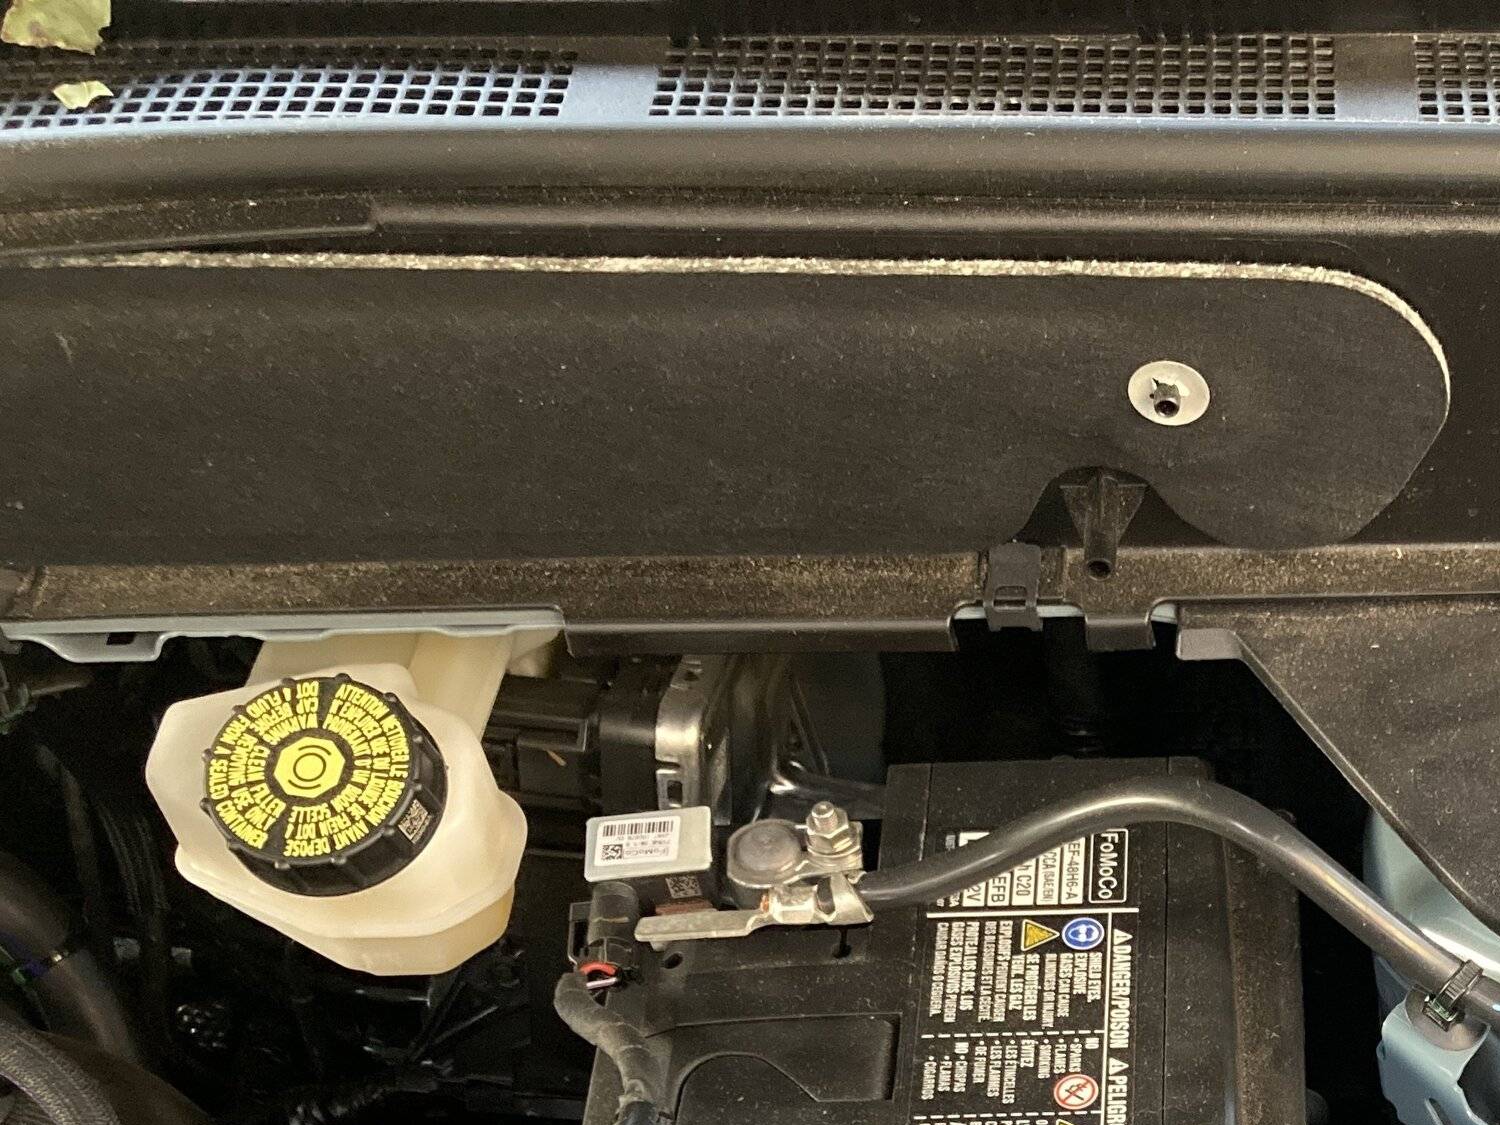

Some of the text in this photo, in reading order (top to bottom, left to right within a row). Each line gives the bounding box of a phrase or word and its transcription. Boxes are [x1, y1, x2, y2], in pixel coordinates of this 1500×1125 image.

[246, 691, 282, 717] FLUID
[297, 681, 319, 698] DOT
[335, 684, 390, 719] ATTENTION
[296, 697, 318, 714] CAP
[214, 746, 231, 754] A
[209, 759, 229, 800] SEALED
[390, 765, 408, 778] LE
[289, 803, 331, 822] SCELLE
[296, 824, 316, 839] DOT
[333, 820, 369, 850] AVANT
[283, 837, 331, 856] DEPOSE
[1097, 833, 1118, 899] FoMoCo
[992, 877, 1006, 902] EFB
[1016, 875, 1031, 896] C20
[935, 922, 949, 949] CAUSAR
[950, 922, 964, 946] GASES
[965, 922, 980, 955] PROTEJA
[985, 921, 997, 934] DES
[947, 947, 962, 993] EXPLOSIVOS
[964, 956, 977, 970] LOS
[983, 936, 996, 975] BLESSURES
[982, 976, 994, 984] ET
[993, 921, 1012, 1022] EXPLOSIFS PEUVENT CAUSER
[1009, 955, 1023, 1010] YEUX. LES GAZ
[1057, 953, 1073, 1017] GASES CAN CAUSE
[1073, 953, 1087, 994] EXPLOSIVE
[1087, 952, 1102, 1002] SHIELD EYES.
[981, 985, 993, 994] LA
[1023, 954, 1041, 1020] SE PROTÉGER LES
[1044, 992, 1056, 1002] OR
[1110, 944, 1131, 1048] DANGER/POISON
[944, 994, 958, 1022] PUEDEN
[960, 995, 974, 1011] LOS
[1020, 1040, 1038, 1067] ÉVITEZ
[1070, 1043, 1082, 1072] SPARKS
[1086, 1038, 1099, 1049] NO
[953, 1042, 969, 1092] NO CHISPAS
[973, 1046, 985, 1083] DE FUMER
[987, 1046, 1000, 1097] LES FLAMMES
[1038, 1045, 1050, 1078] SMOKING
[1054, 1044, 1066, 1074] FLAMES
[922, 1061, 935, 1100] CIGARROS
[938, 1061, 951, 1091] FLAMAS
[1002, 1046, 1018, 1104] LES ÉTINCELLES
